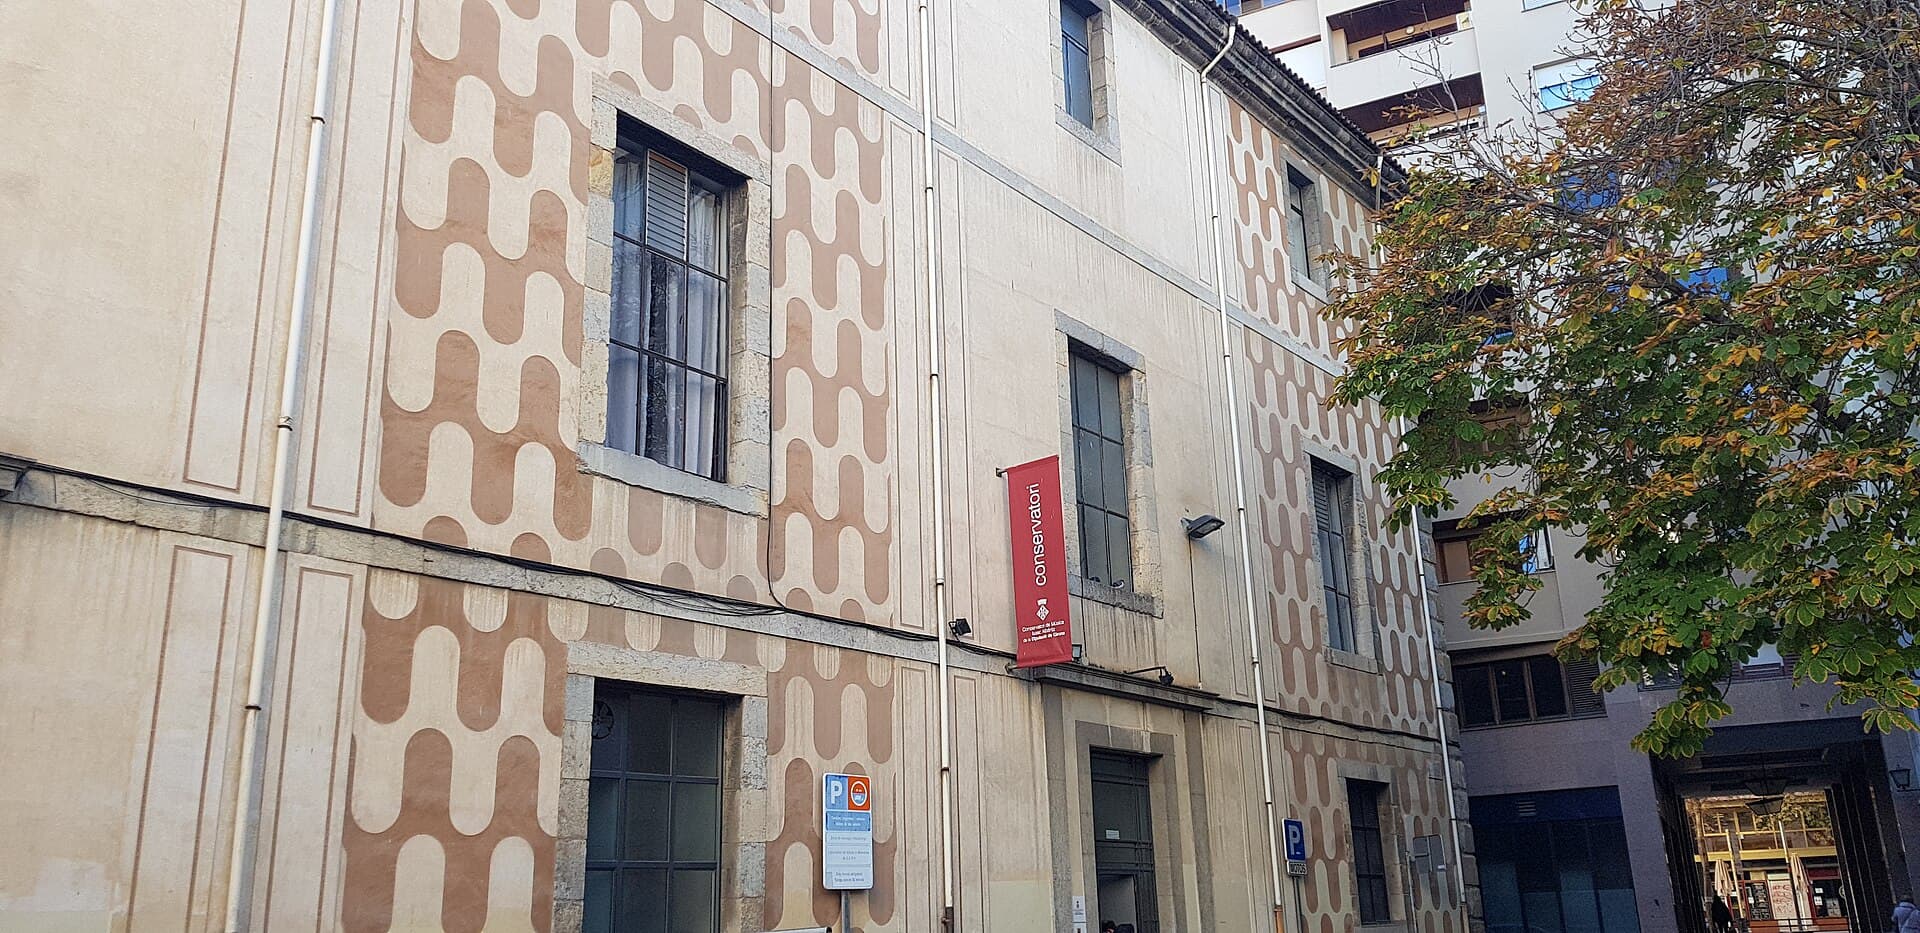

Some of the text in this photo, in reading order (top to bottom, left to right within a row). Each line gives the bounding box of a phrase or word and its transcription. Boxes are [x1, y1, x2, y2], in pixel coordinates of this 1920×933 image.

[1026, 483, 1047, 586] conservatori
[831, 780, 843, 805] P
[1289, 824, 1300, 855] P
